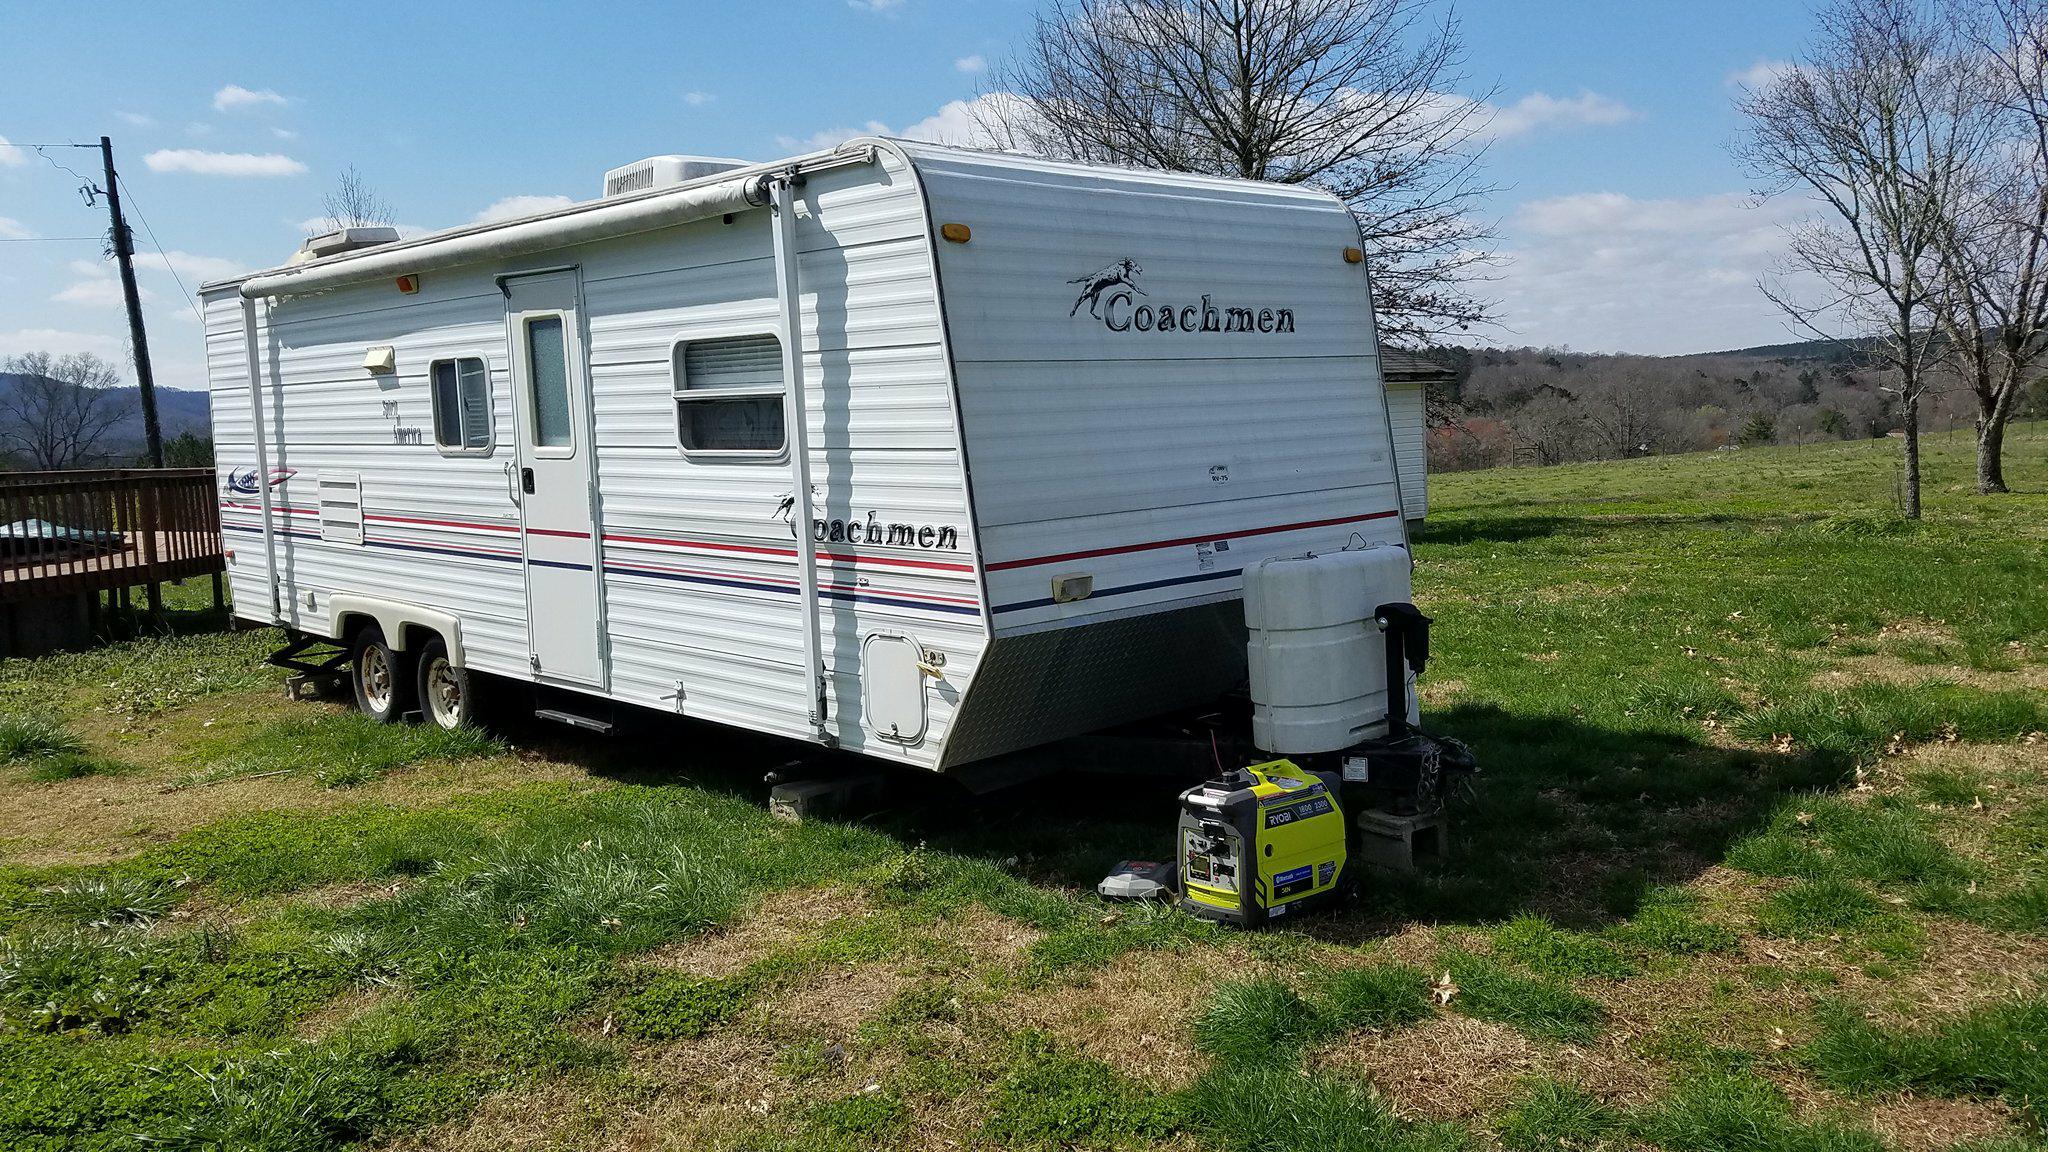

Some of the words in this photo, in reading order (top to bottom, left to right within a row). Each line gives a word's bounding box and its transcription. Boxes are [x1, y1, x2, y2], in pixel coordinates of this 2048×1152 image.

[1103, 291, 1296, 333] Coachmen
[393, 424, 423, 445] America
[790, 510, 959, 550] oachmen
[1268, 811, 1292, 826] RYOBI
[1298, 803, 1313, 813] 1800
[1314, 799, 1329, 809] 2300
